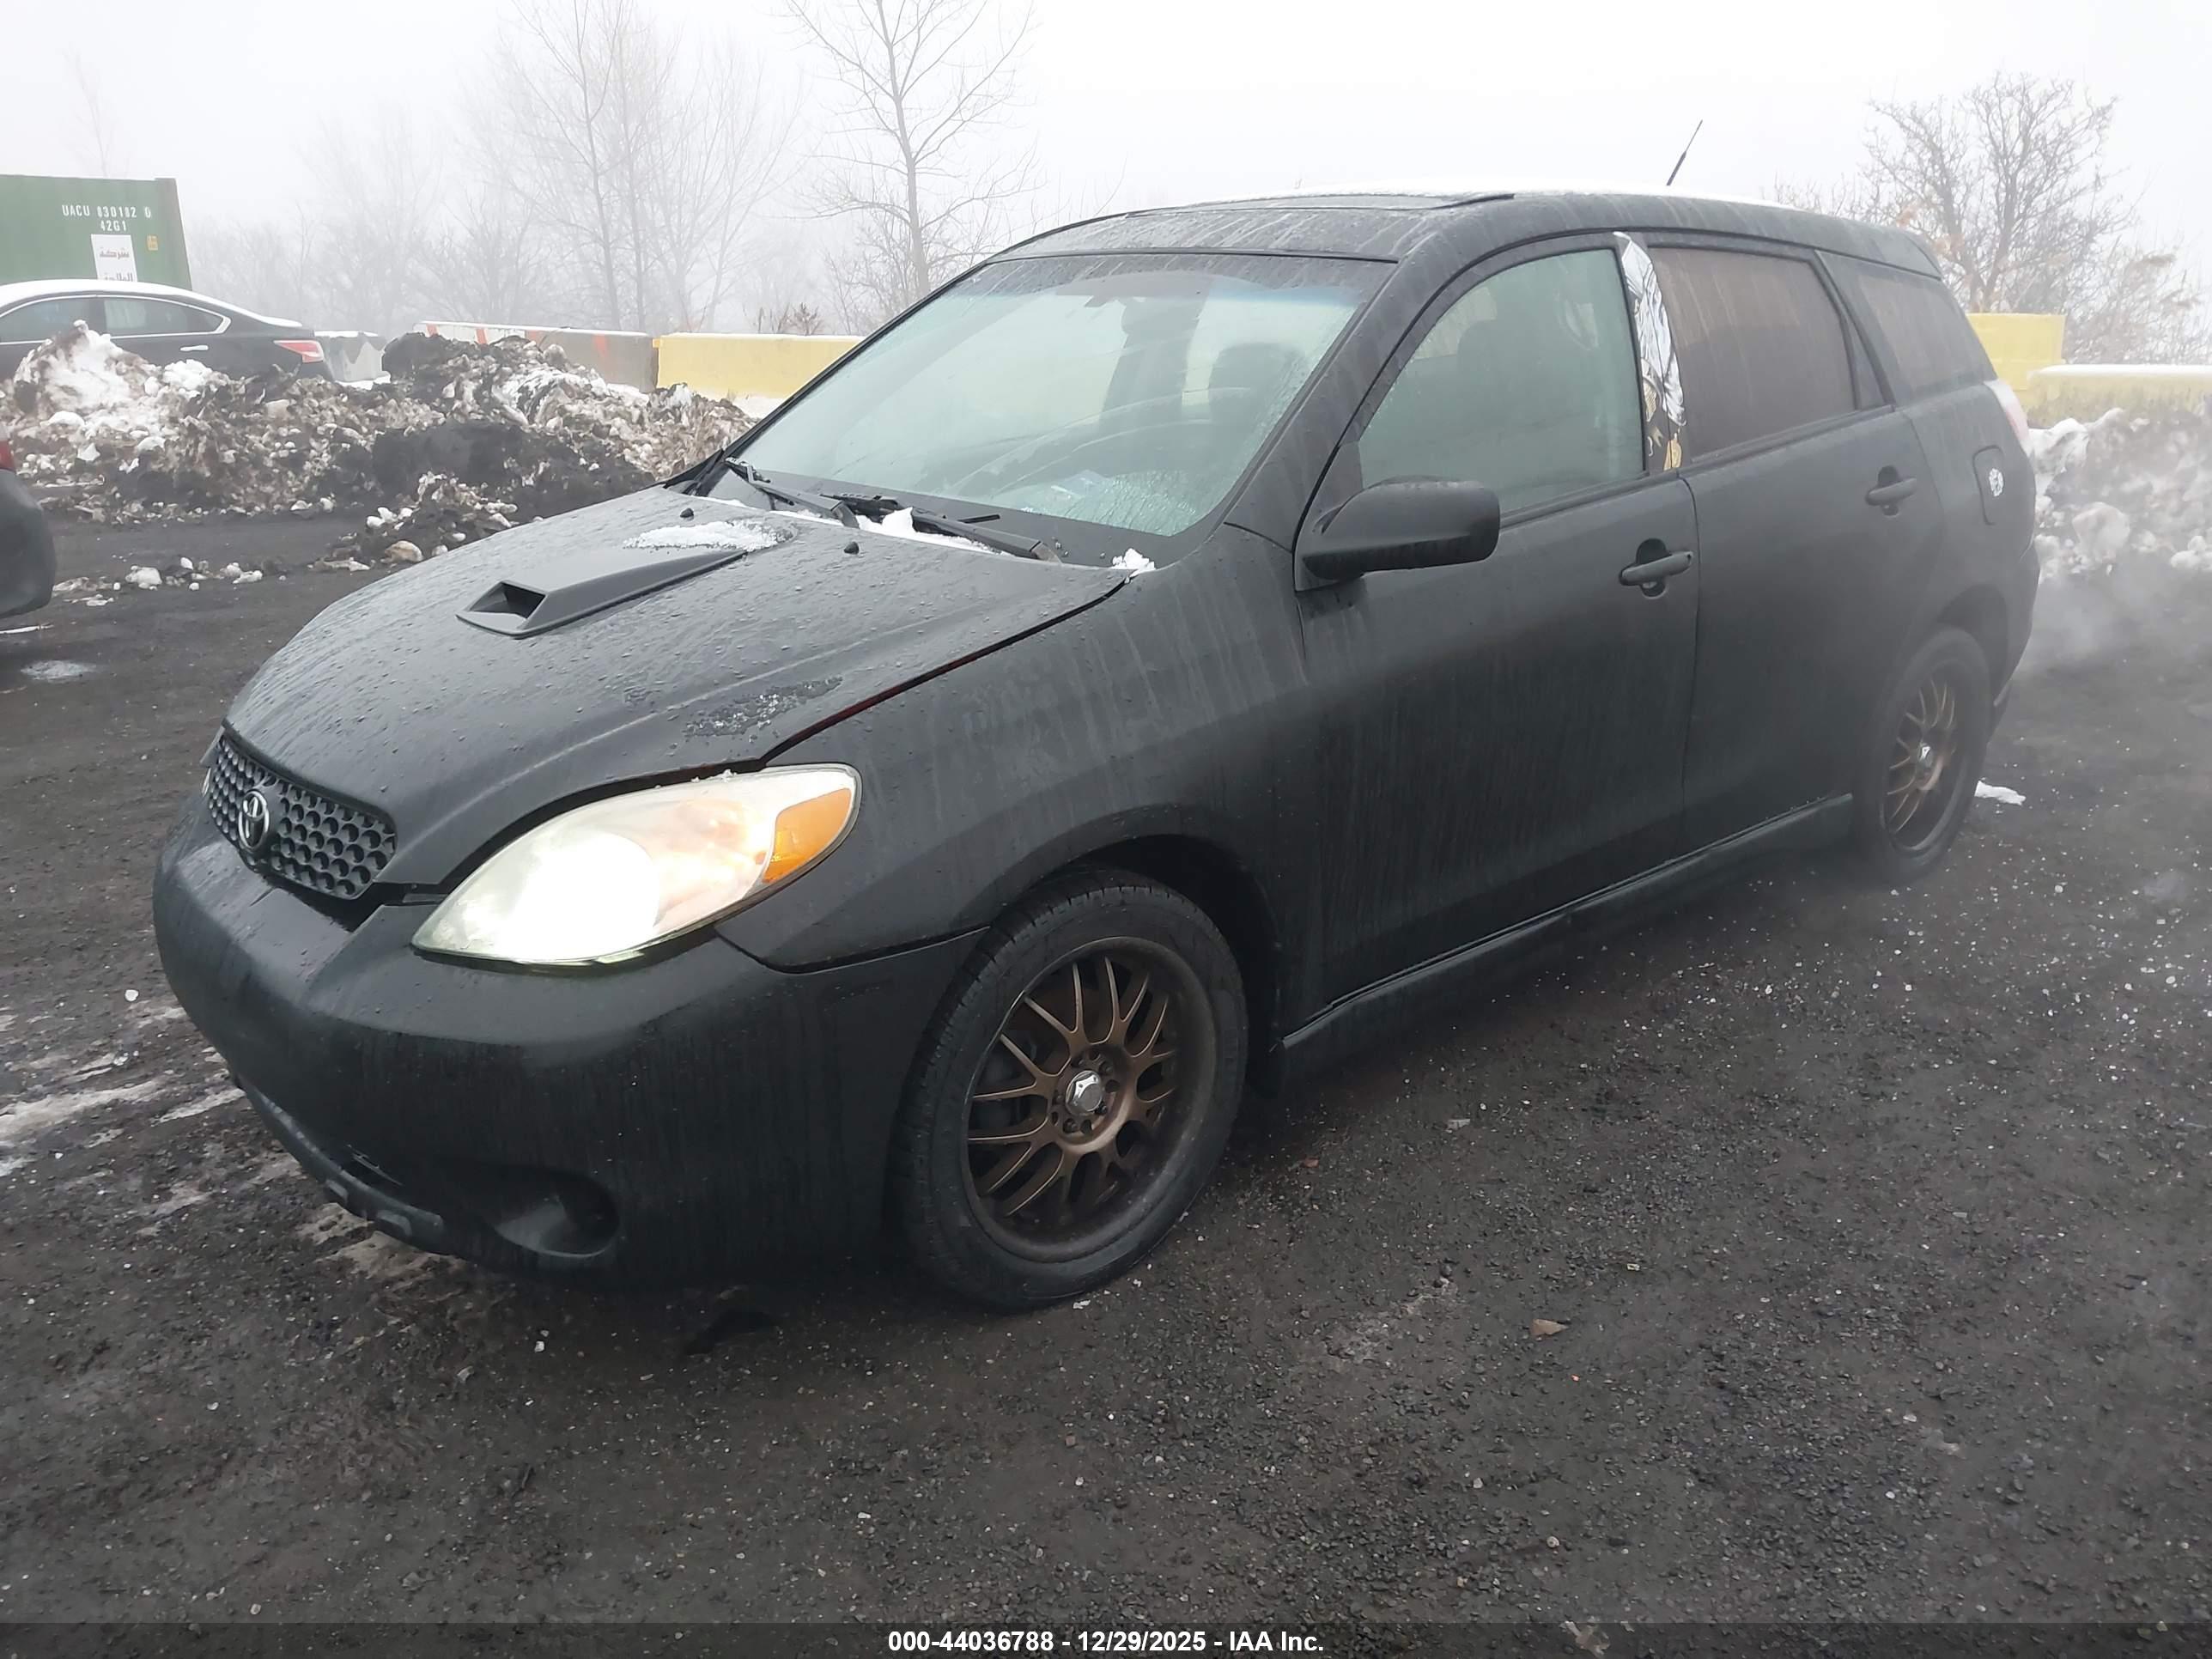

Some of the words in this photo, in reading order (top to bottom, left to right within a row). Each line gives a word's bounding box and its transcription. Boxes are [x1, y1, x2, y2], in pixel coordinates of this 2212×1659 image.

[61, 204, 91, 216] UACU
[96, 205, 137, 218] 830182
[100, 220, 127, 232] 42G1
